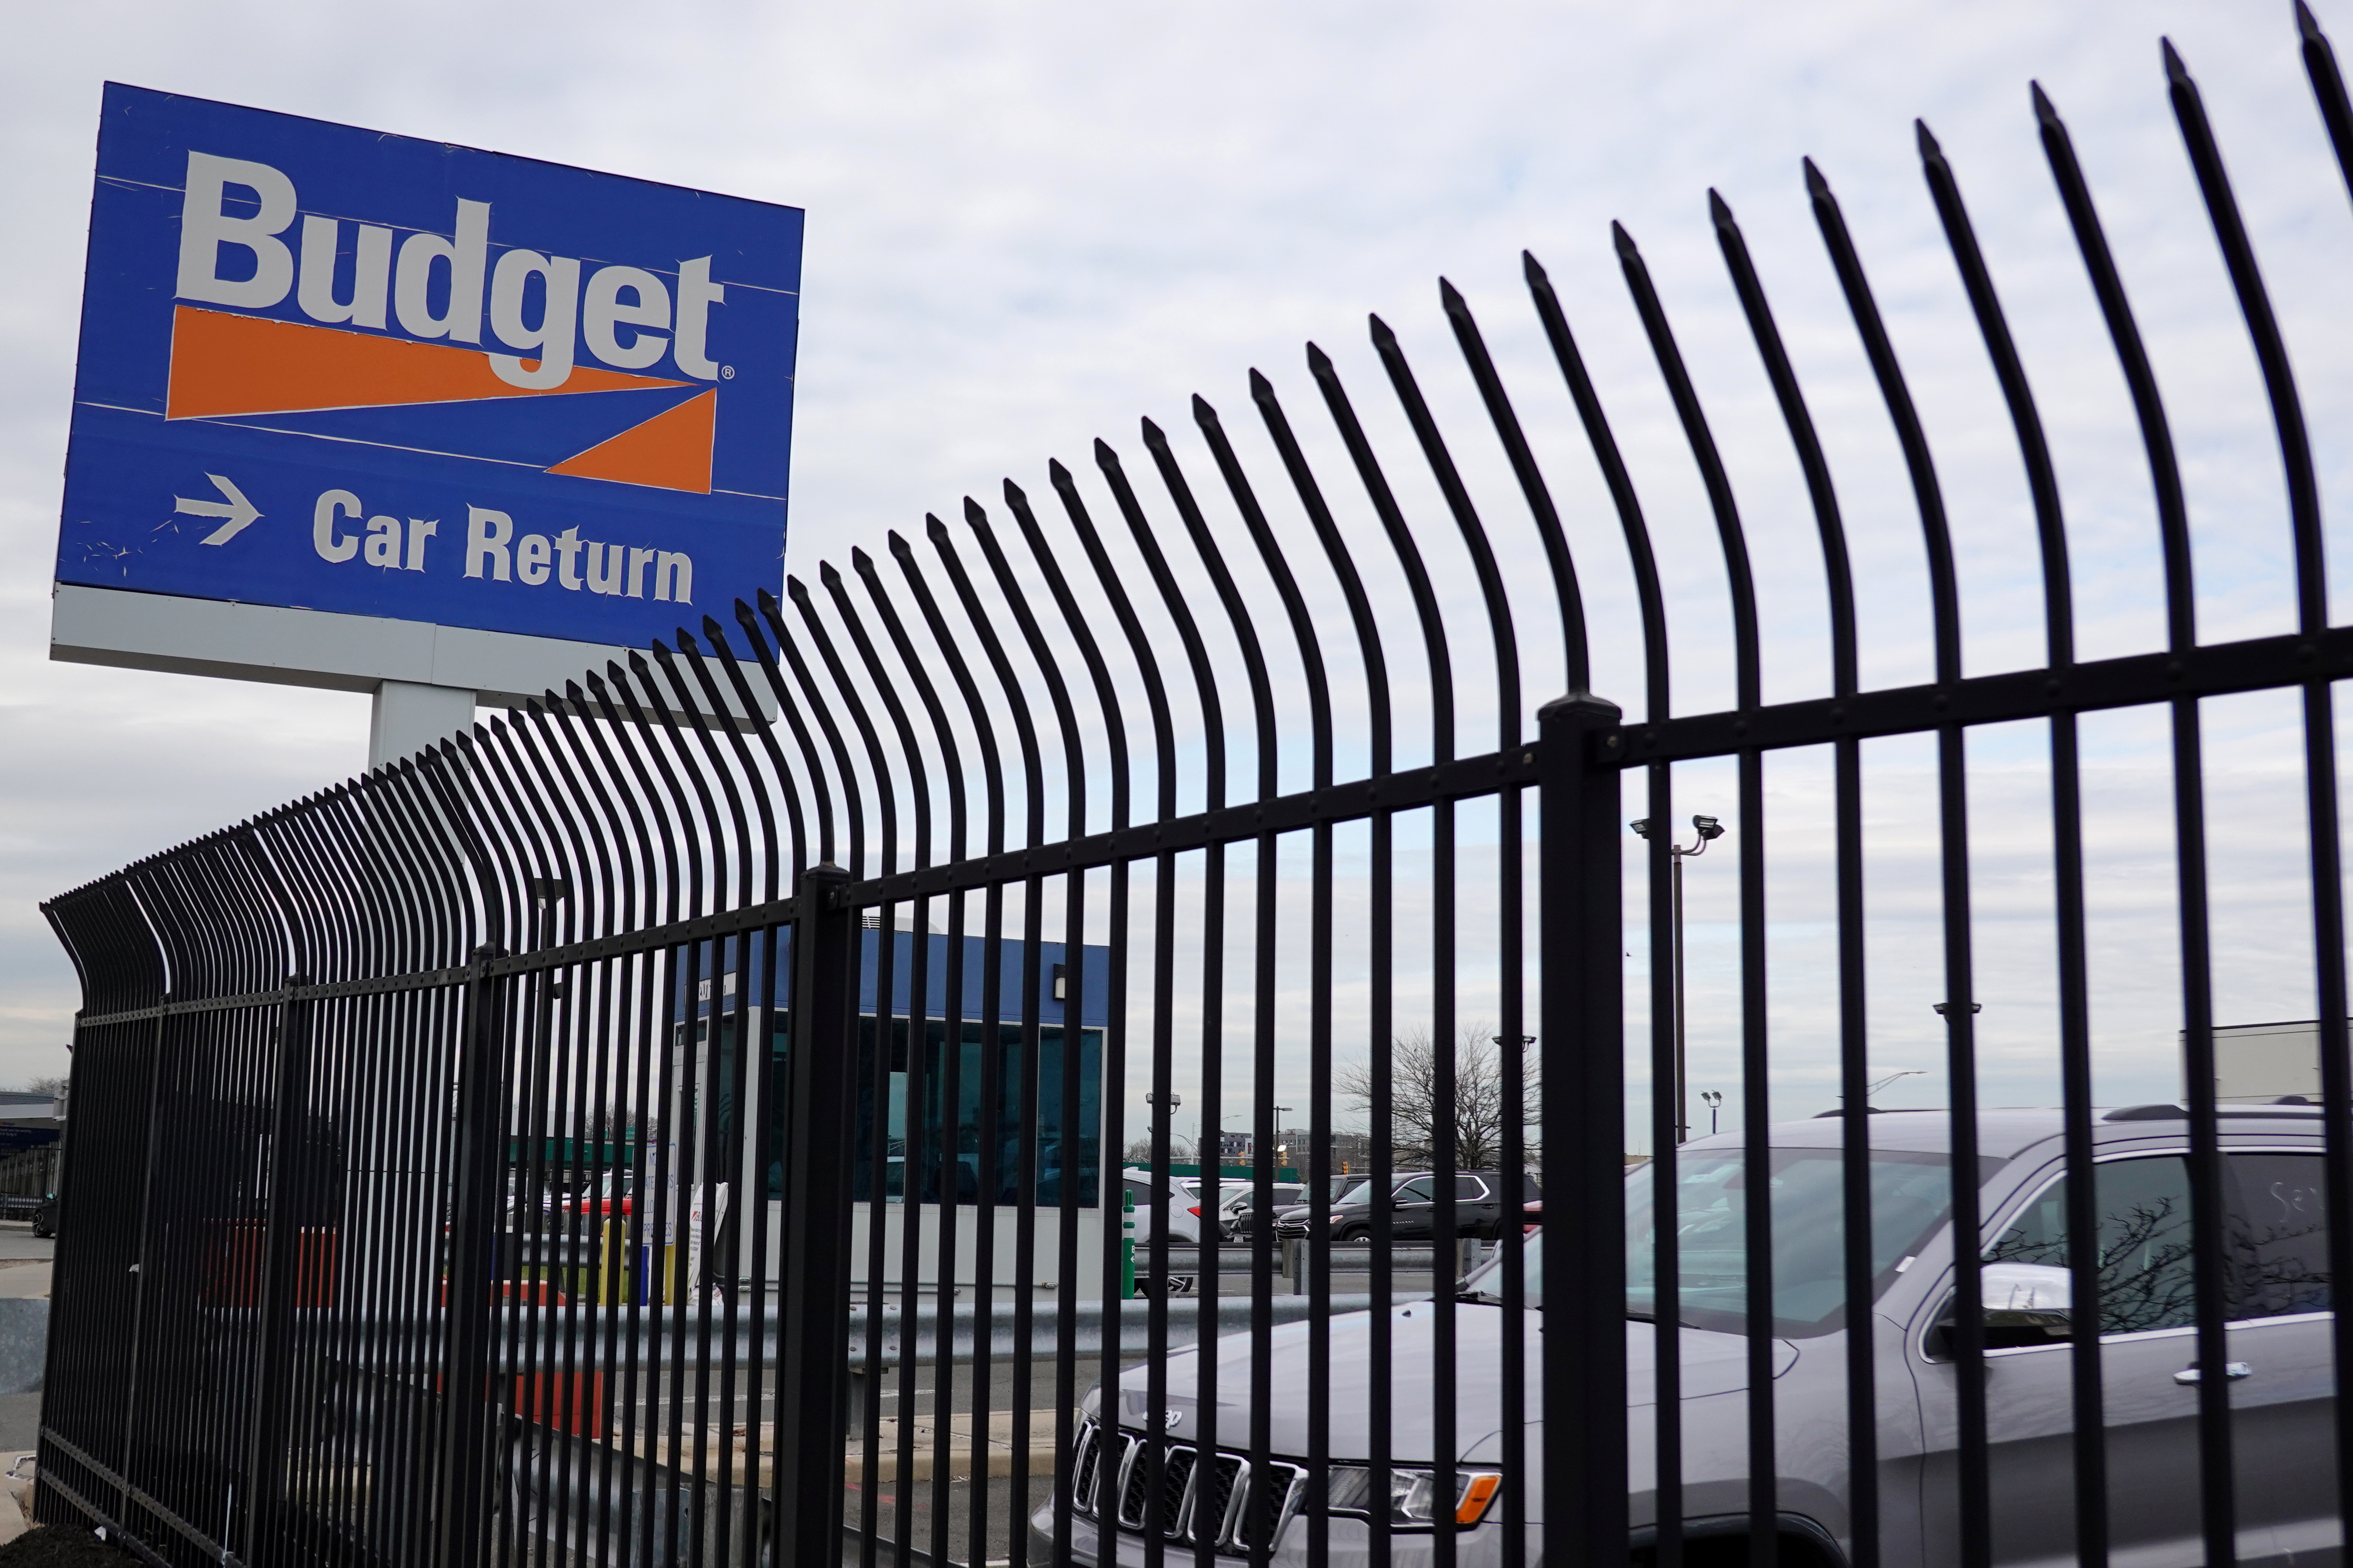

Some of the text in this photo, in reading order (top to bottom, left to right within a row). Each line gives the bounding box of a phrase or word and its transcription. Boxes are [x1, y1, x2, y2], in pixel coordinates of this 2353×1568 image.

[175, 150, 725, 390] Budget
[314, 489, 692, 605] Car Return
